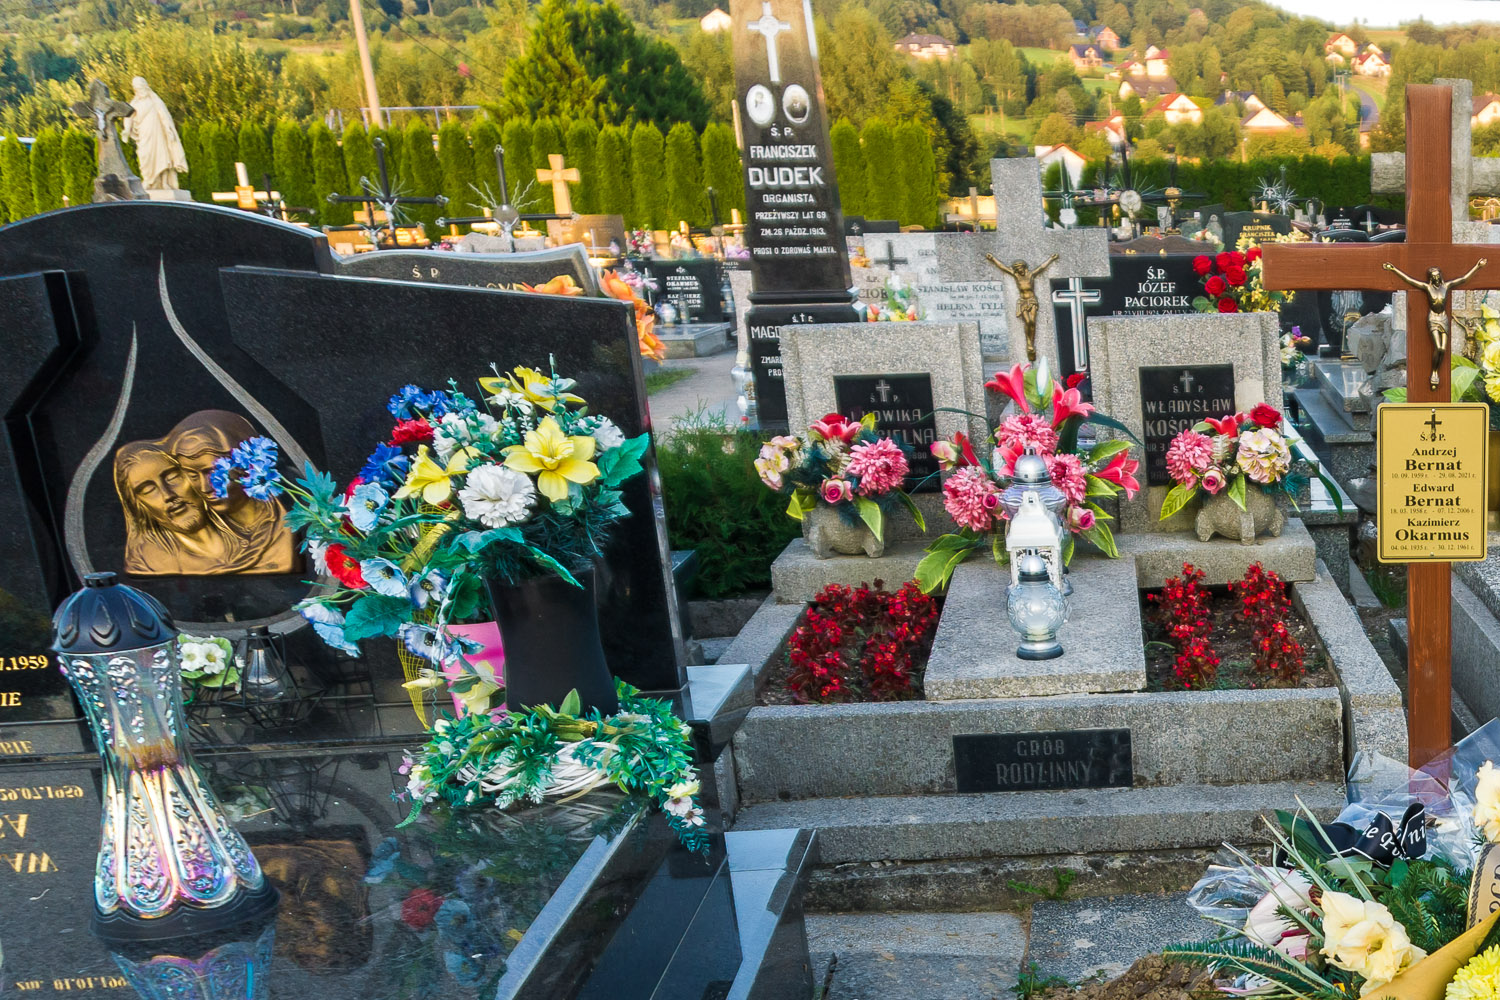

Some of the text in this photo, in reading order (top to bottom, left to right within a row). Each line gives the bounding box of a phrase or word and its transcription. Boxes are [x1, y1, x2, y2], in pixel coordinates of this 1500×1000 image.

[750, 145, 816, 158] FRANCISZEK
[748, 167, 824, 186] DUDEK
[762, 194, 815, 203] ORGANISTA
[802, 211, 814, 219] LAT
[753, 247, 772, 255] PROSI
[1137, 279, 1176, 294] JÓZEF
[1125, 296, 1190, 308] PACIOREK
[1146, 398, 1232, 414] WŁADYSŁAW
[1145, 416, 1203, 437] KOŚCI
[1420, 432, 1446, 442] Ś. P.
[1412, 448, 1457, 458] Andrzej
[1405, 460, 1462, 471] Bernat
[1413, 484, 1455, 492] Edward
[1405, 495, 1462, 506] Bernat
[1408, 518, 1460, 526] Kazimierz
[1395, 528, 1470, 541] Okarmus
[0, 654, 49, 672] .1959
[1016, 736, 1065, 756] GRÓB
[996, 760, 1092, 785] RODZINNY
